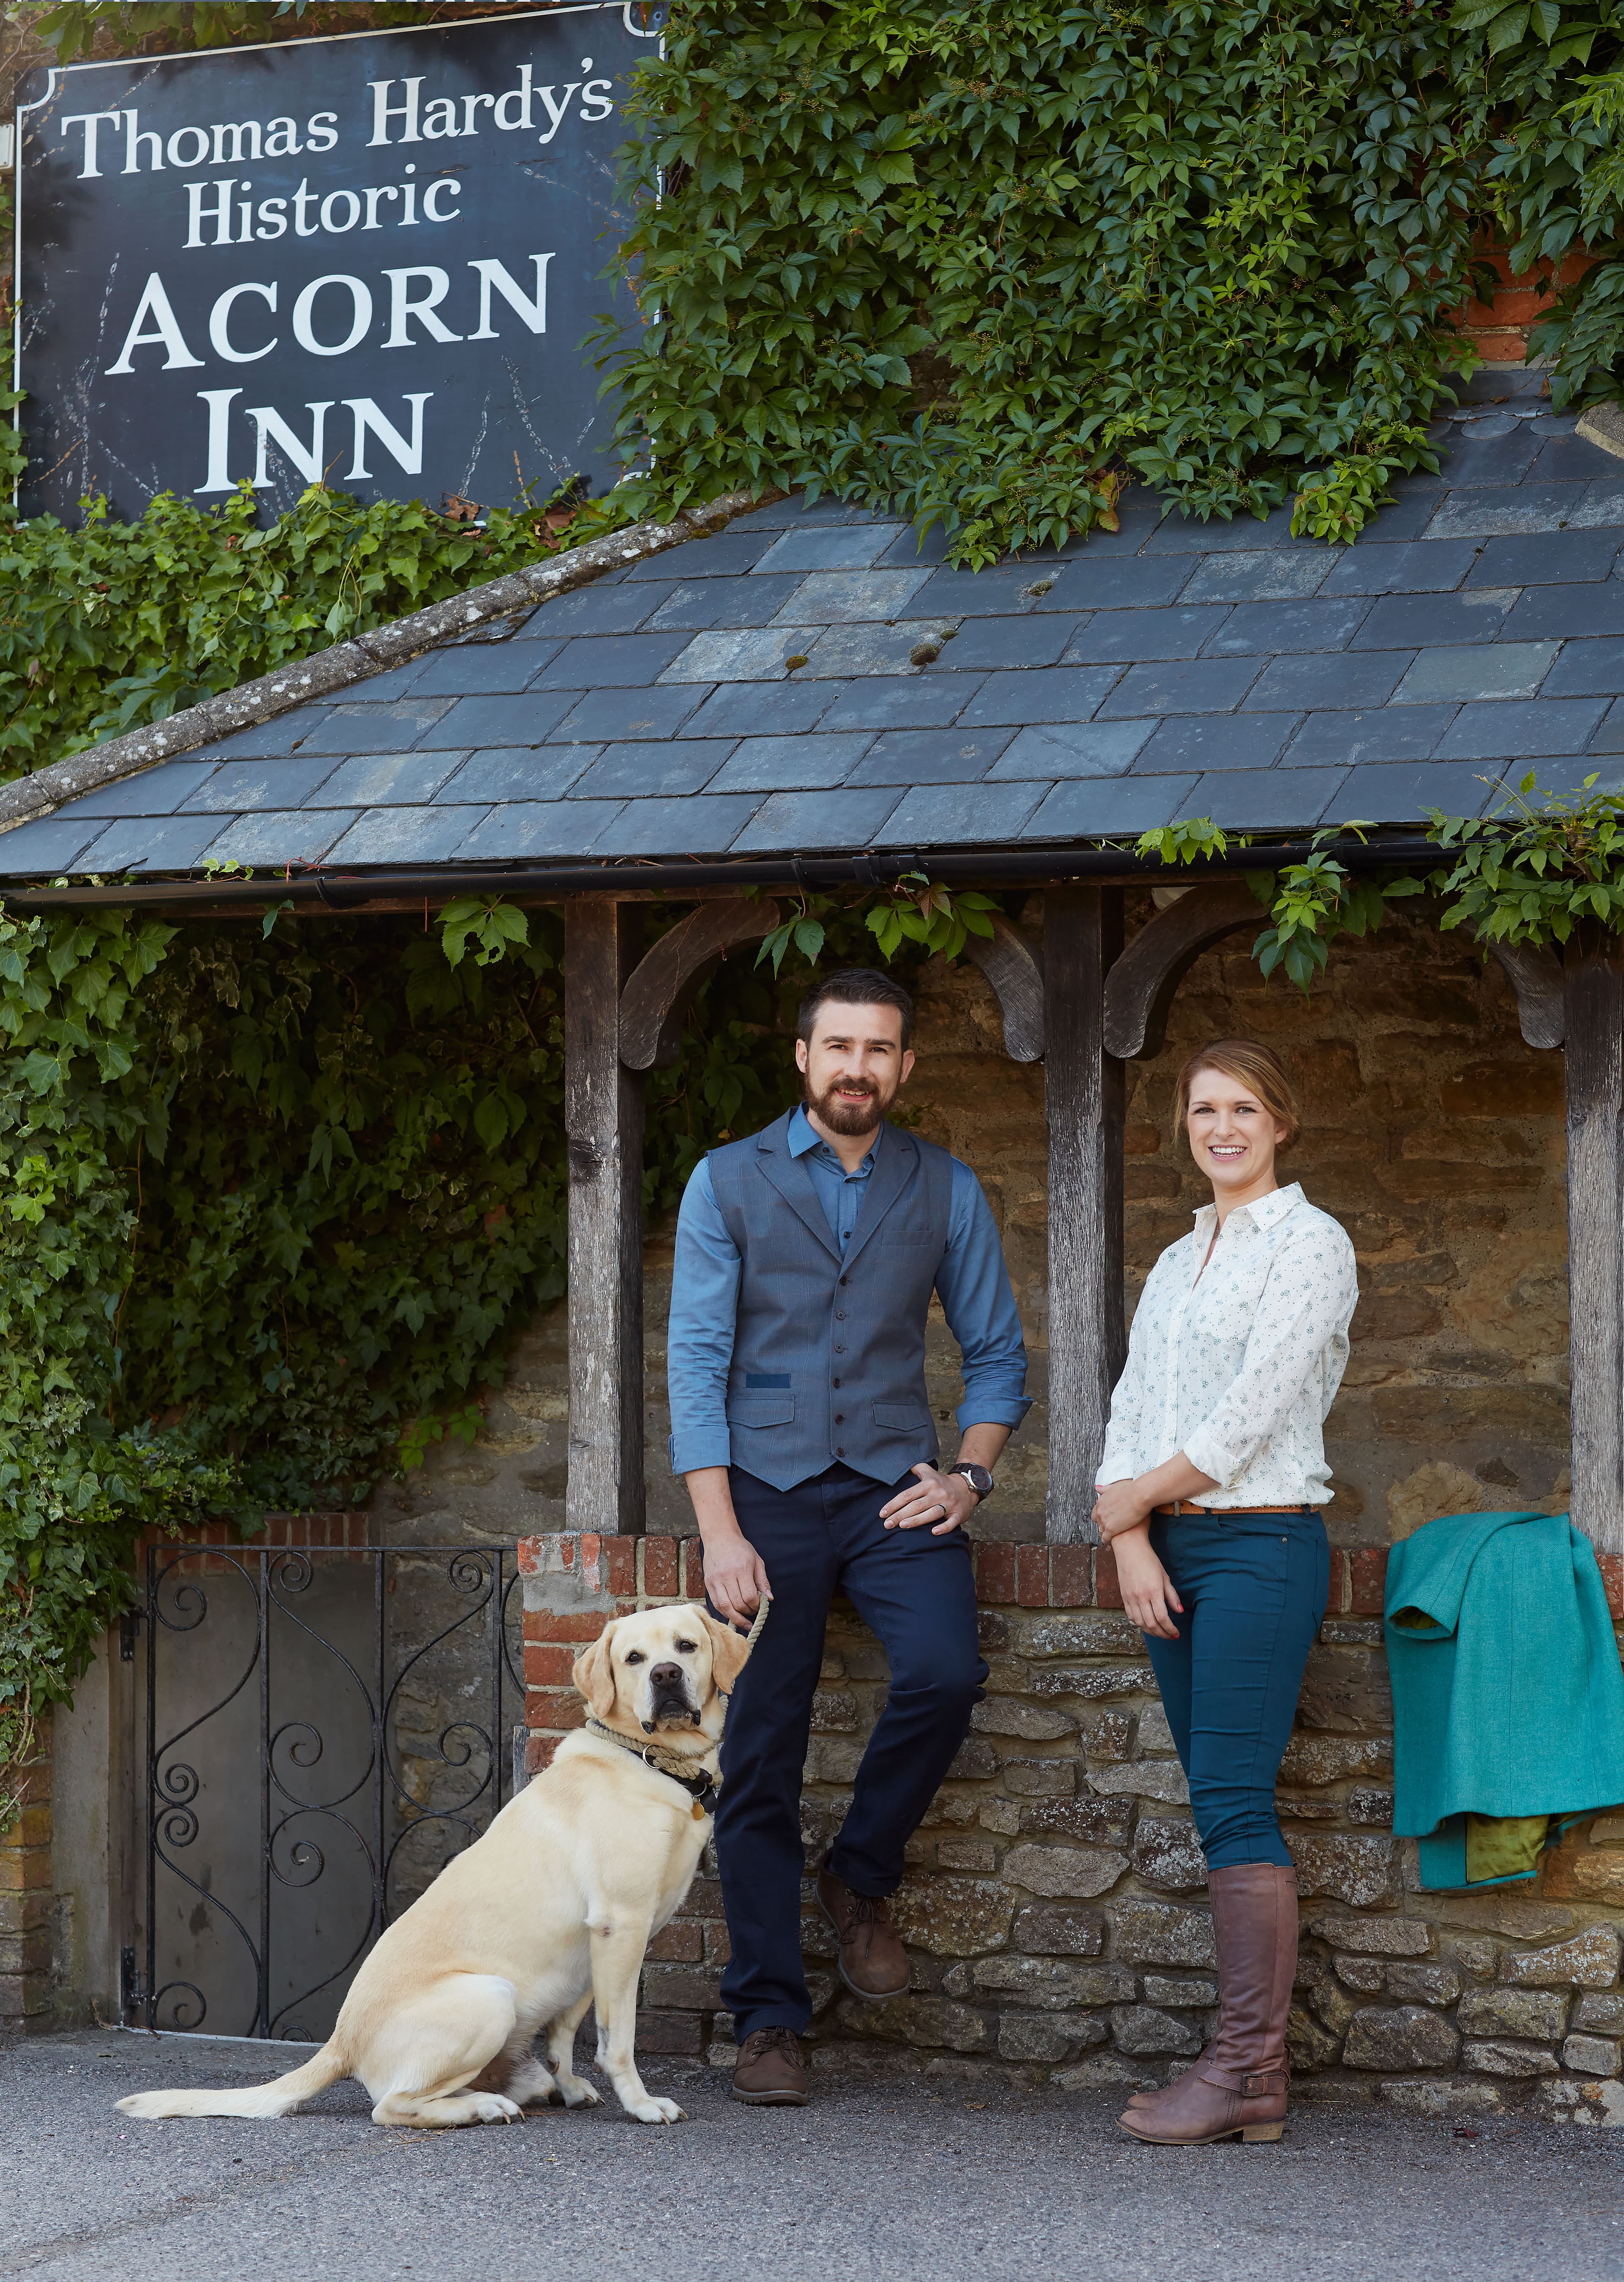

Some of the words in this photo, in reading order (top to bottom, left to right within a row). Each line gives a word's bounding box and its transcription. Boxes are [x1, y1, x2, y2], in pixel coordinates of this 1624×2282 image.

[60, 109, 338, 179] Thomas
[365, 57, 613, 147] Hardy's
[183, 164, 461, 248] Historic
[104, 252, 556, 376] ACORN
[193, 388, 434, 493] INN
